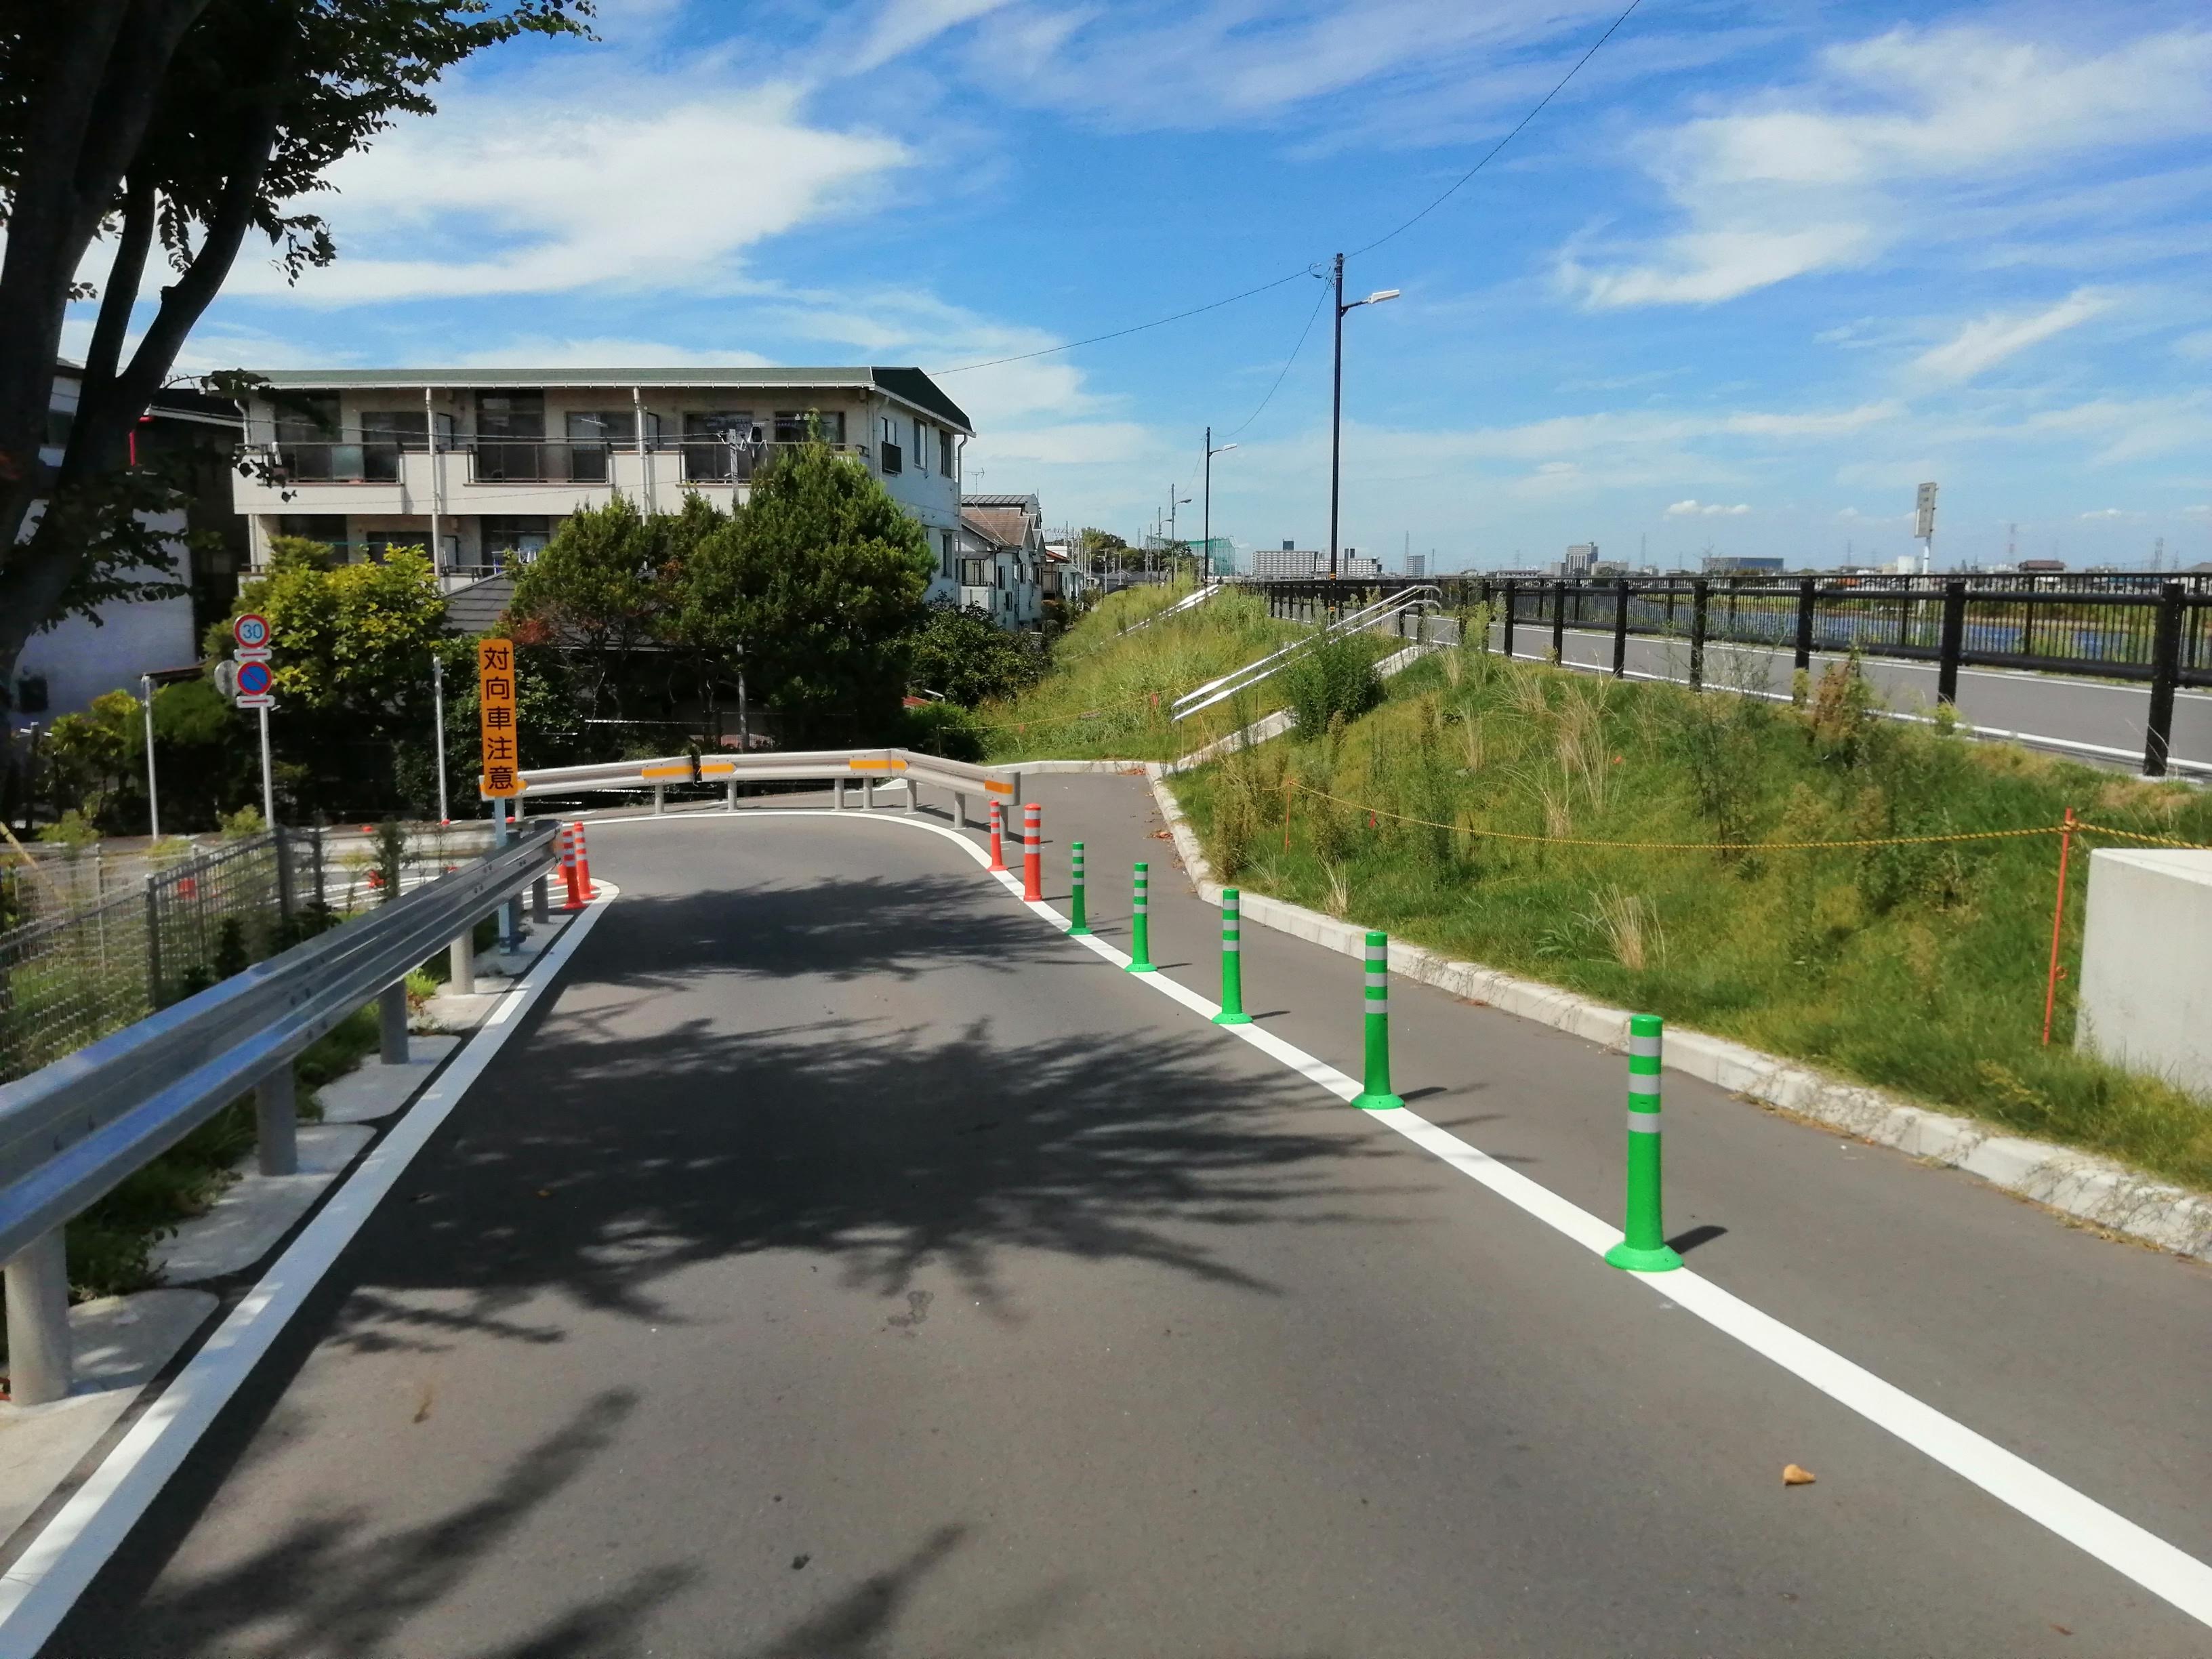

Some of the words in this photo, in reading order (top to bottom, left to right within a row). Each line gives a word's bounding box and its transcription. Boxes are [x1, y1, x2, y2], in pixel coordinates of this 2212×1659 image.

[243, 623, 262, 639] 30
[484, 647, 514, 790] 対向車注意
